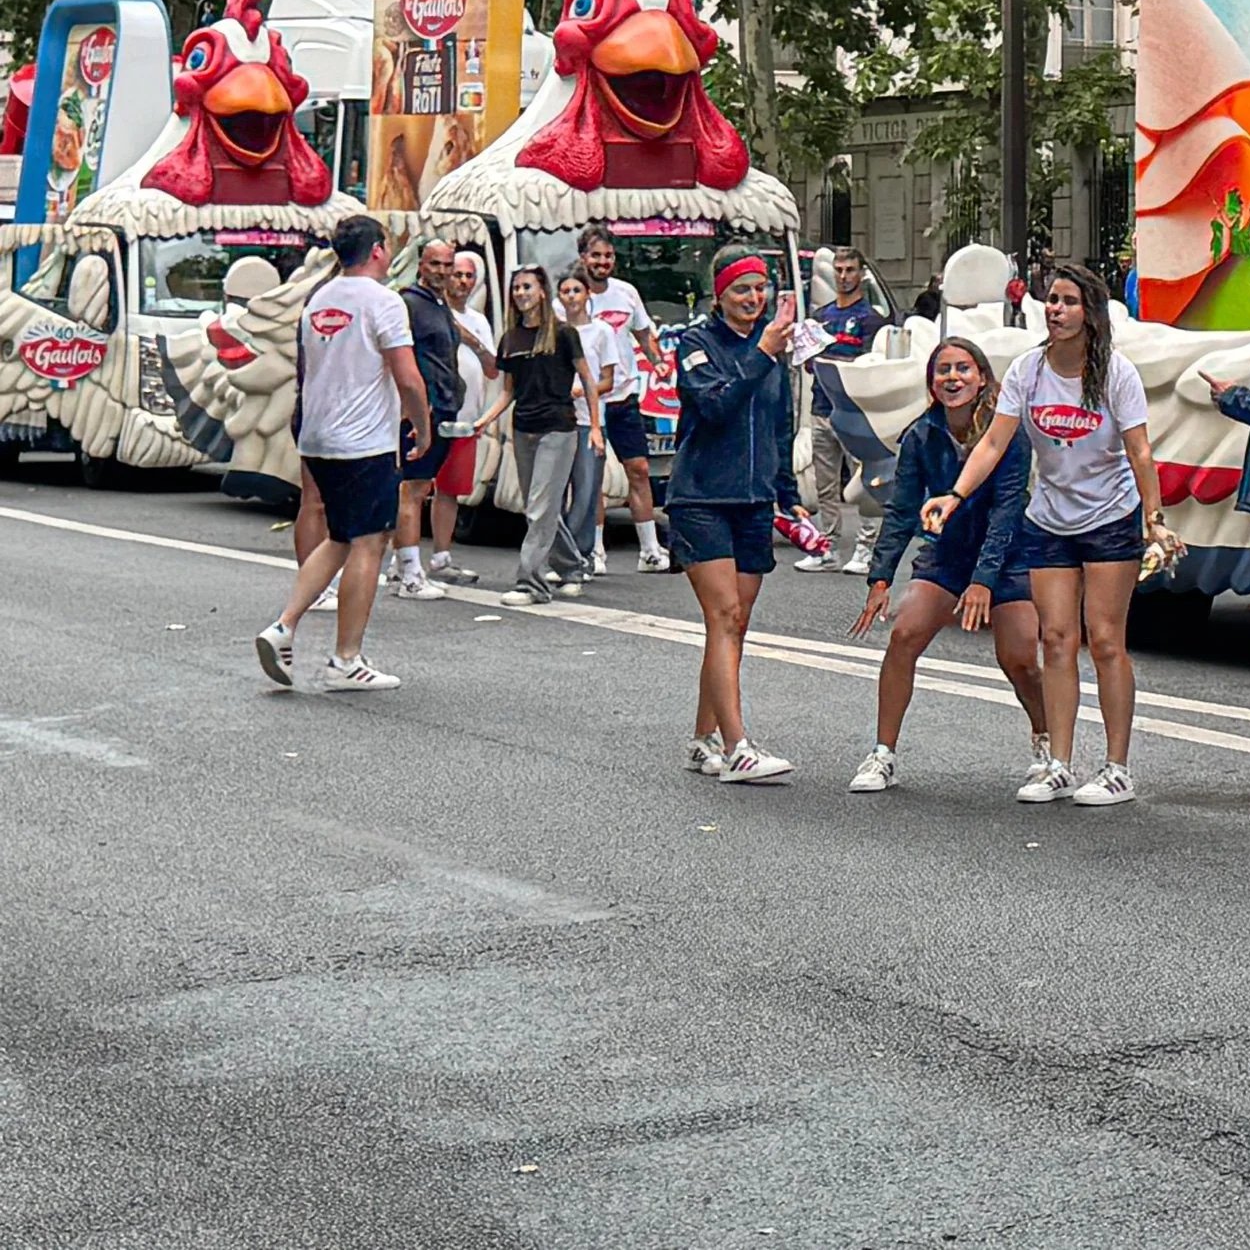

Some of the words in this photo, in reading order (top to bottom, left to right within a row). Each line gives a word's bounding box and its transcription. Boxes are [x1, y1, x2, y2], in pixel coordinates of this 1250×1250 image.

[861, 118, 908, 141] VICTOR
[35, 341, 102, 371] Gaulois
[1039, 407, 1099, 431] Gaulois
